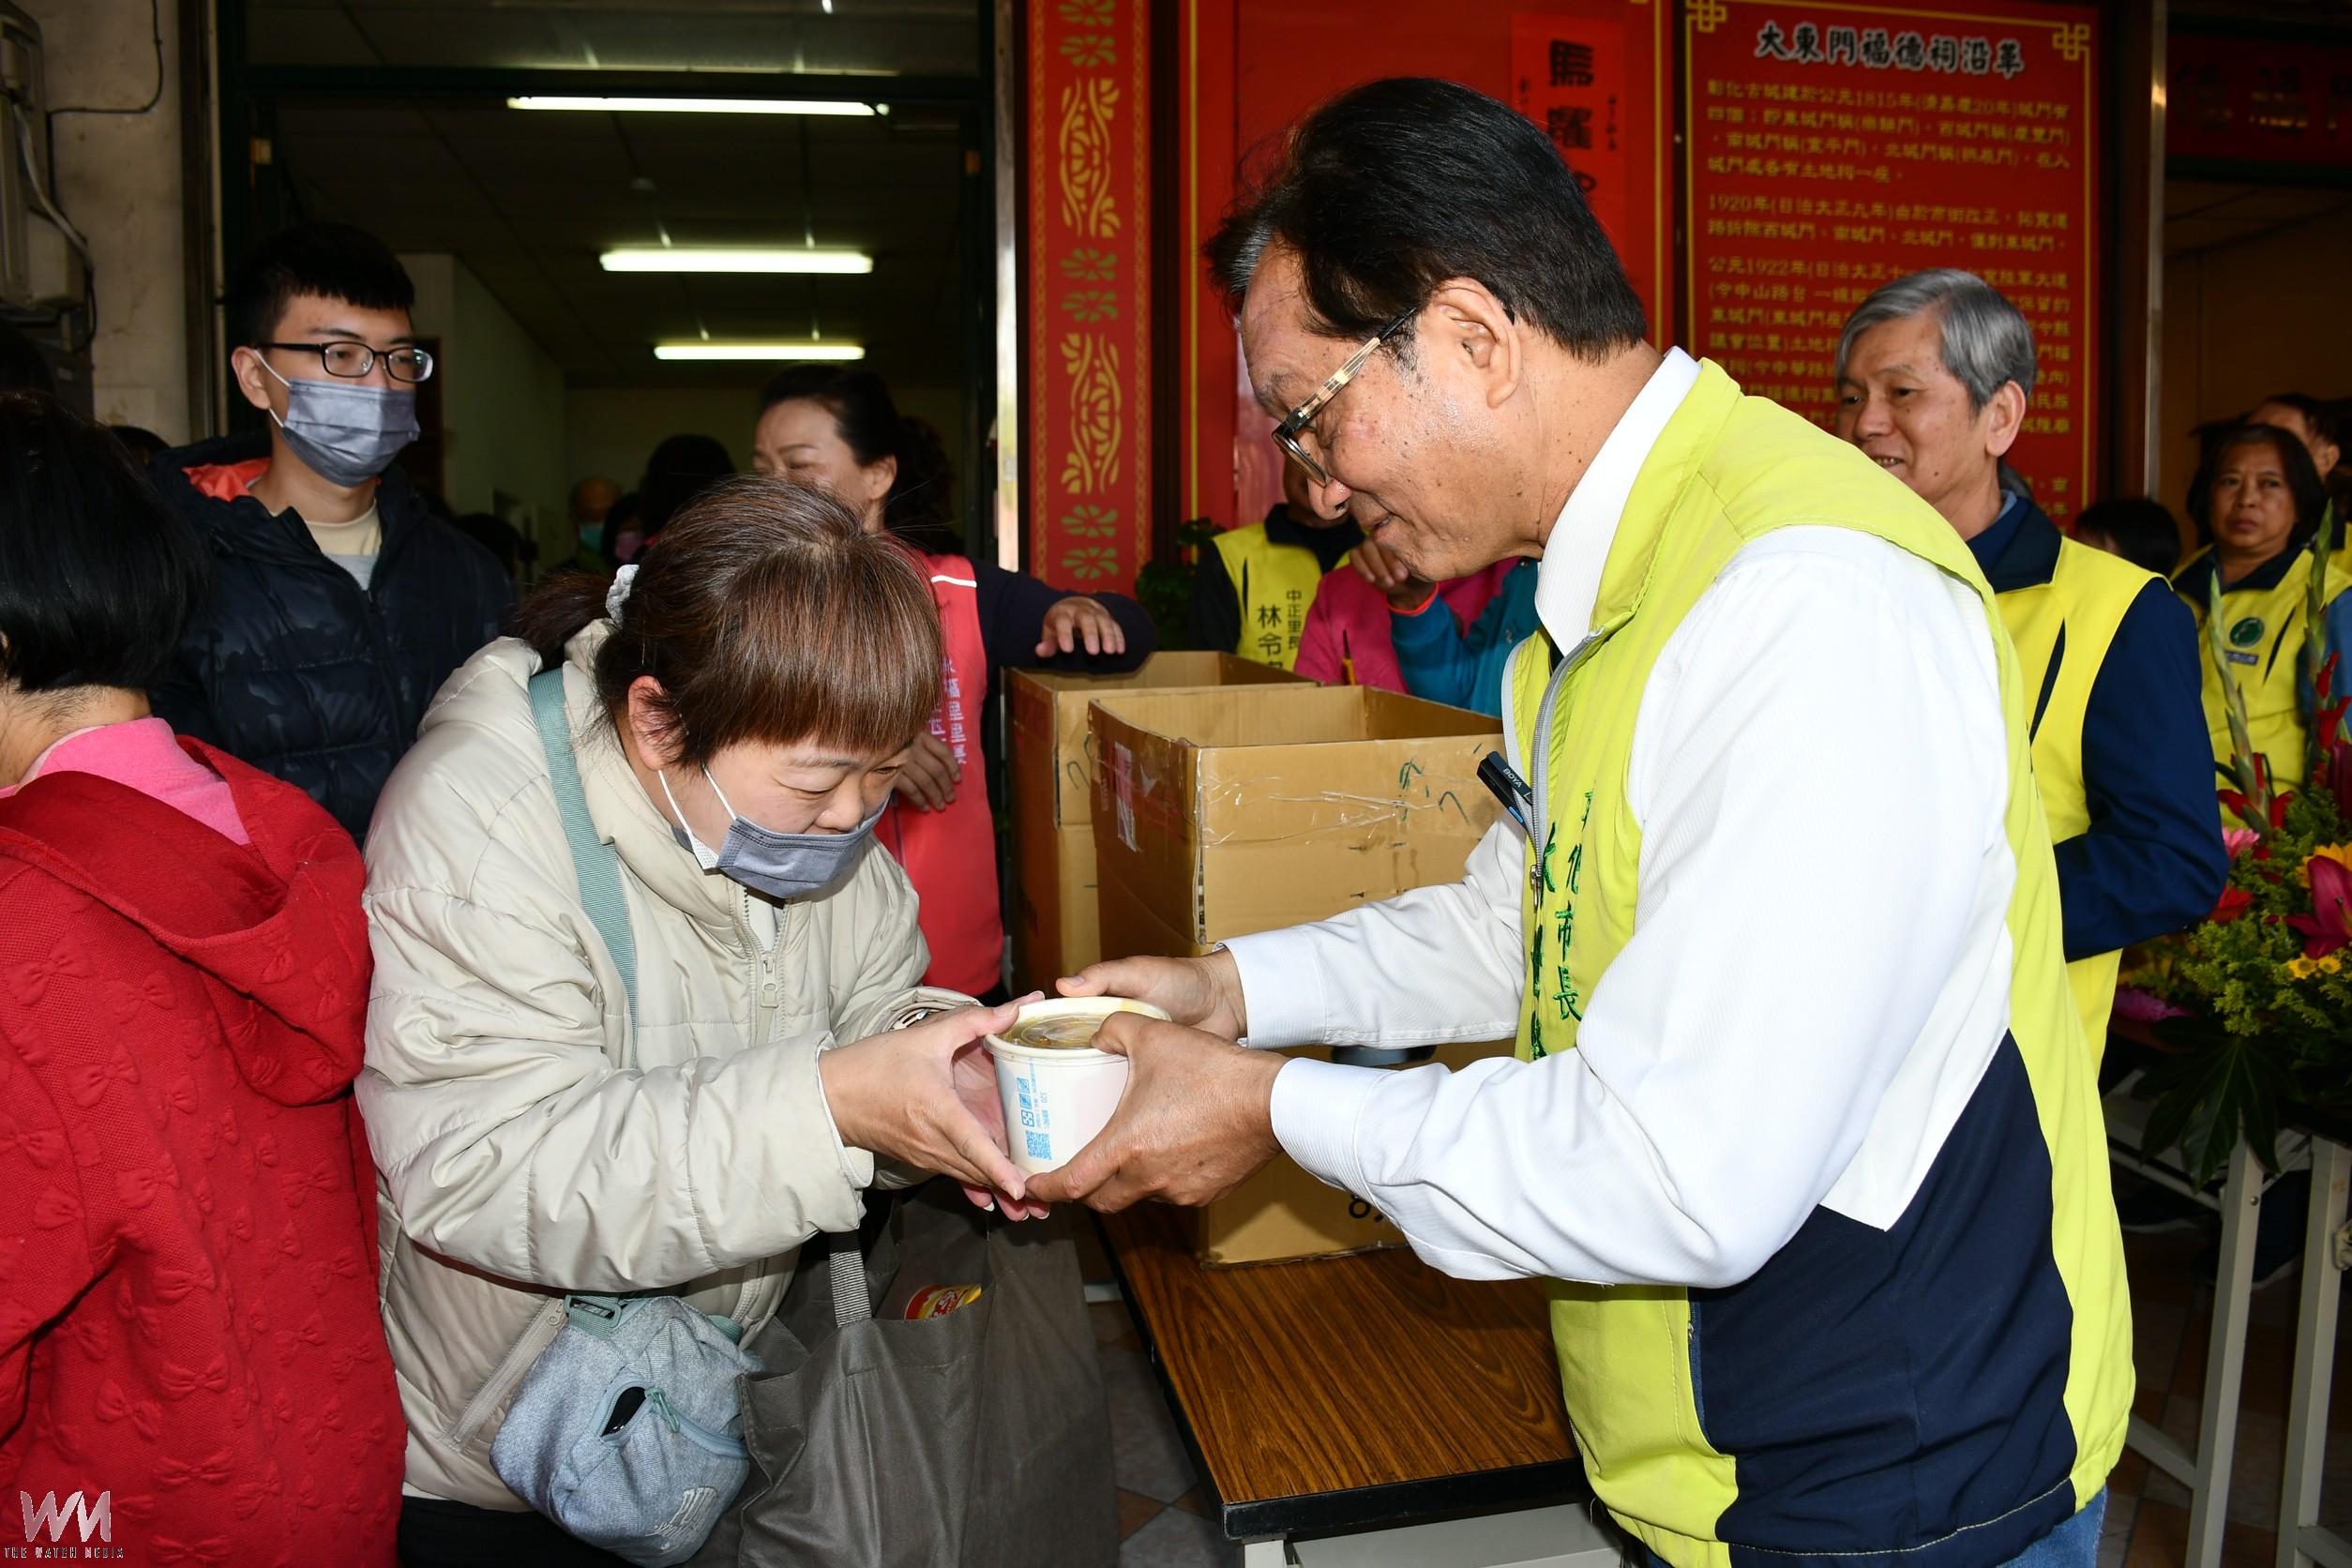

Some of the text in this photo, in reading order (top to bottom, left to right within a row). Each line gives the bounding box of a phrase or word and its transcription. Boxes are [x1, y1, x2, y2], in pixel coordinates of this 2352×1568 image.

[1754, 20, 2026, 79] 大東門福德祠沿革
[1257, 604, 1284, 669] 林令
[1502, 767, 1522, 789] BOYA
